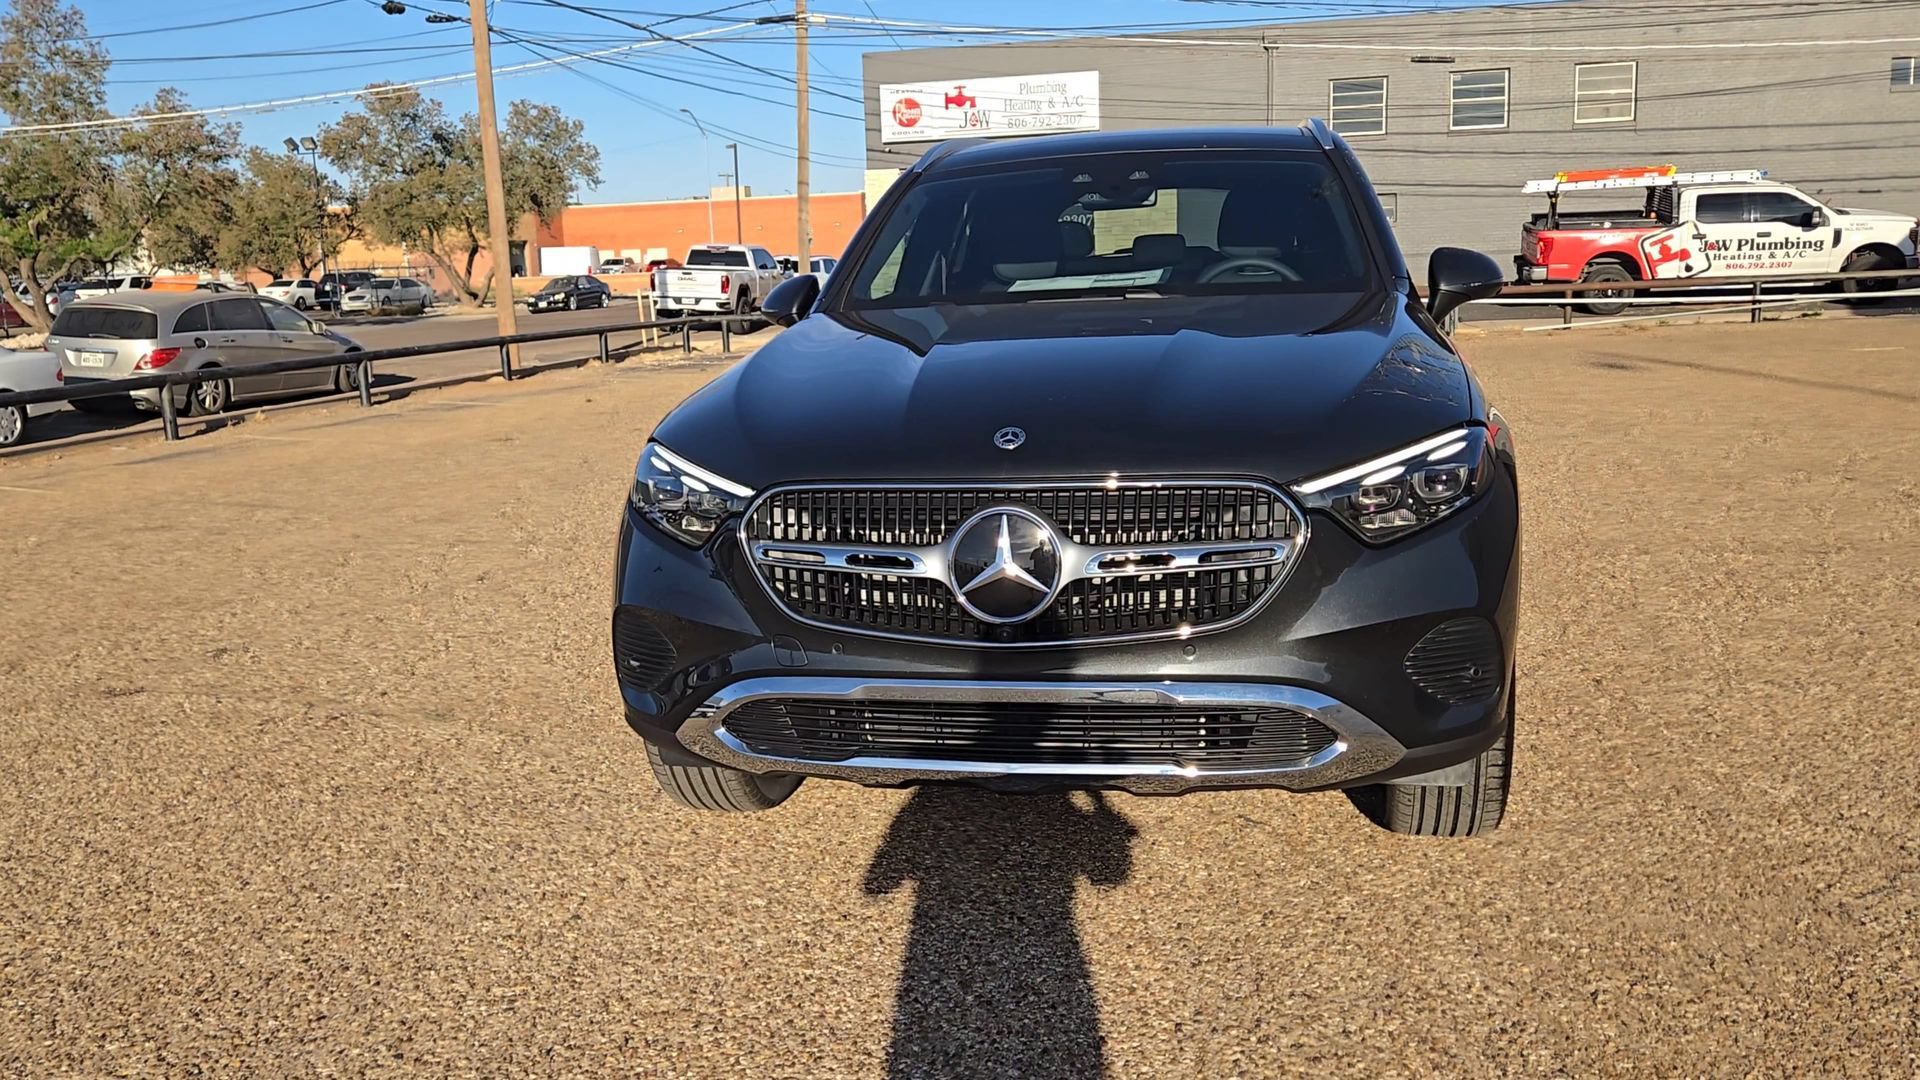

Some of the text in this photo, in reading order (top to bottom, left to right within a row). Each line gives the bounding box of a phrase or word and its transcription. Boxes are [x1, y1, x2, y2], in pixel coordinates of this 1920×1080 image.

[1019, 80, 1067, 96] Plumbing
[1004, 95, 1084, 112] Heating & A/C
[1007, 115, 1082, 128] 806-792-2307
[1699, 237, 1825, 252] J&W Plumbing
[1713, 250, 1807, 261] Heating & A/C
[1725, 261, 1792, 270] 806.792.2307
